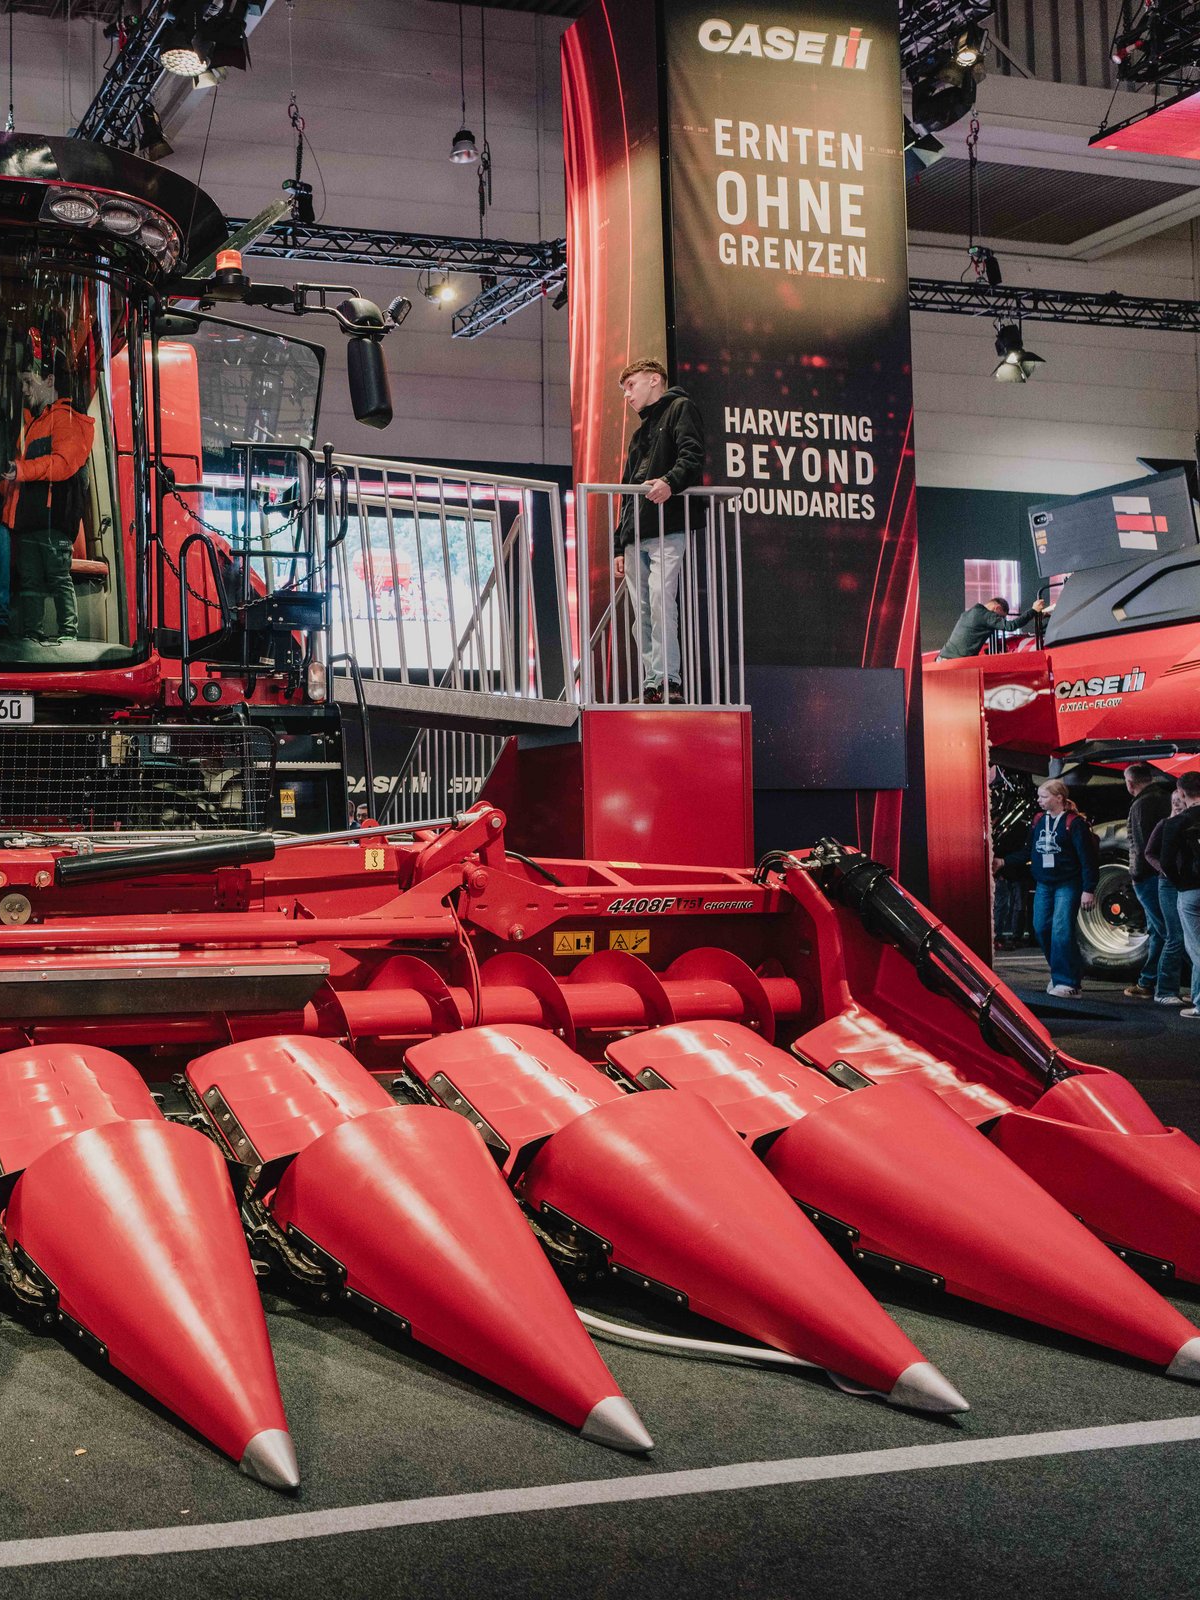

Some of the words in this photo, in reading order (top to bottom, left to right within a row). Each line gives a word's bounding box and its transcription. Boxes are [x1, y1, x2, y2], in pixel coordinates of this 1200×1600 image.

[698, 18, 828, 65] CASE
[714, 118, 864, 171] ERNTEN
[716, 170, 866, 238] OHNE
[718, 232, 867, 277] GRENZEN
[724, 406, 873, 443] HARVESTING
[725, 442, 875, 486] BEYOND
[727, 487, 876, 520] BOUNDARIES
[1054, 675, 1121, 699] CASE
[607, 897, 676, 914] 4408F
[683, 899, 697, 910] 75
[703, 900, 754, 910] CHOPPING
